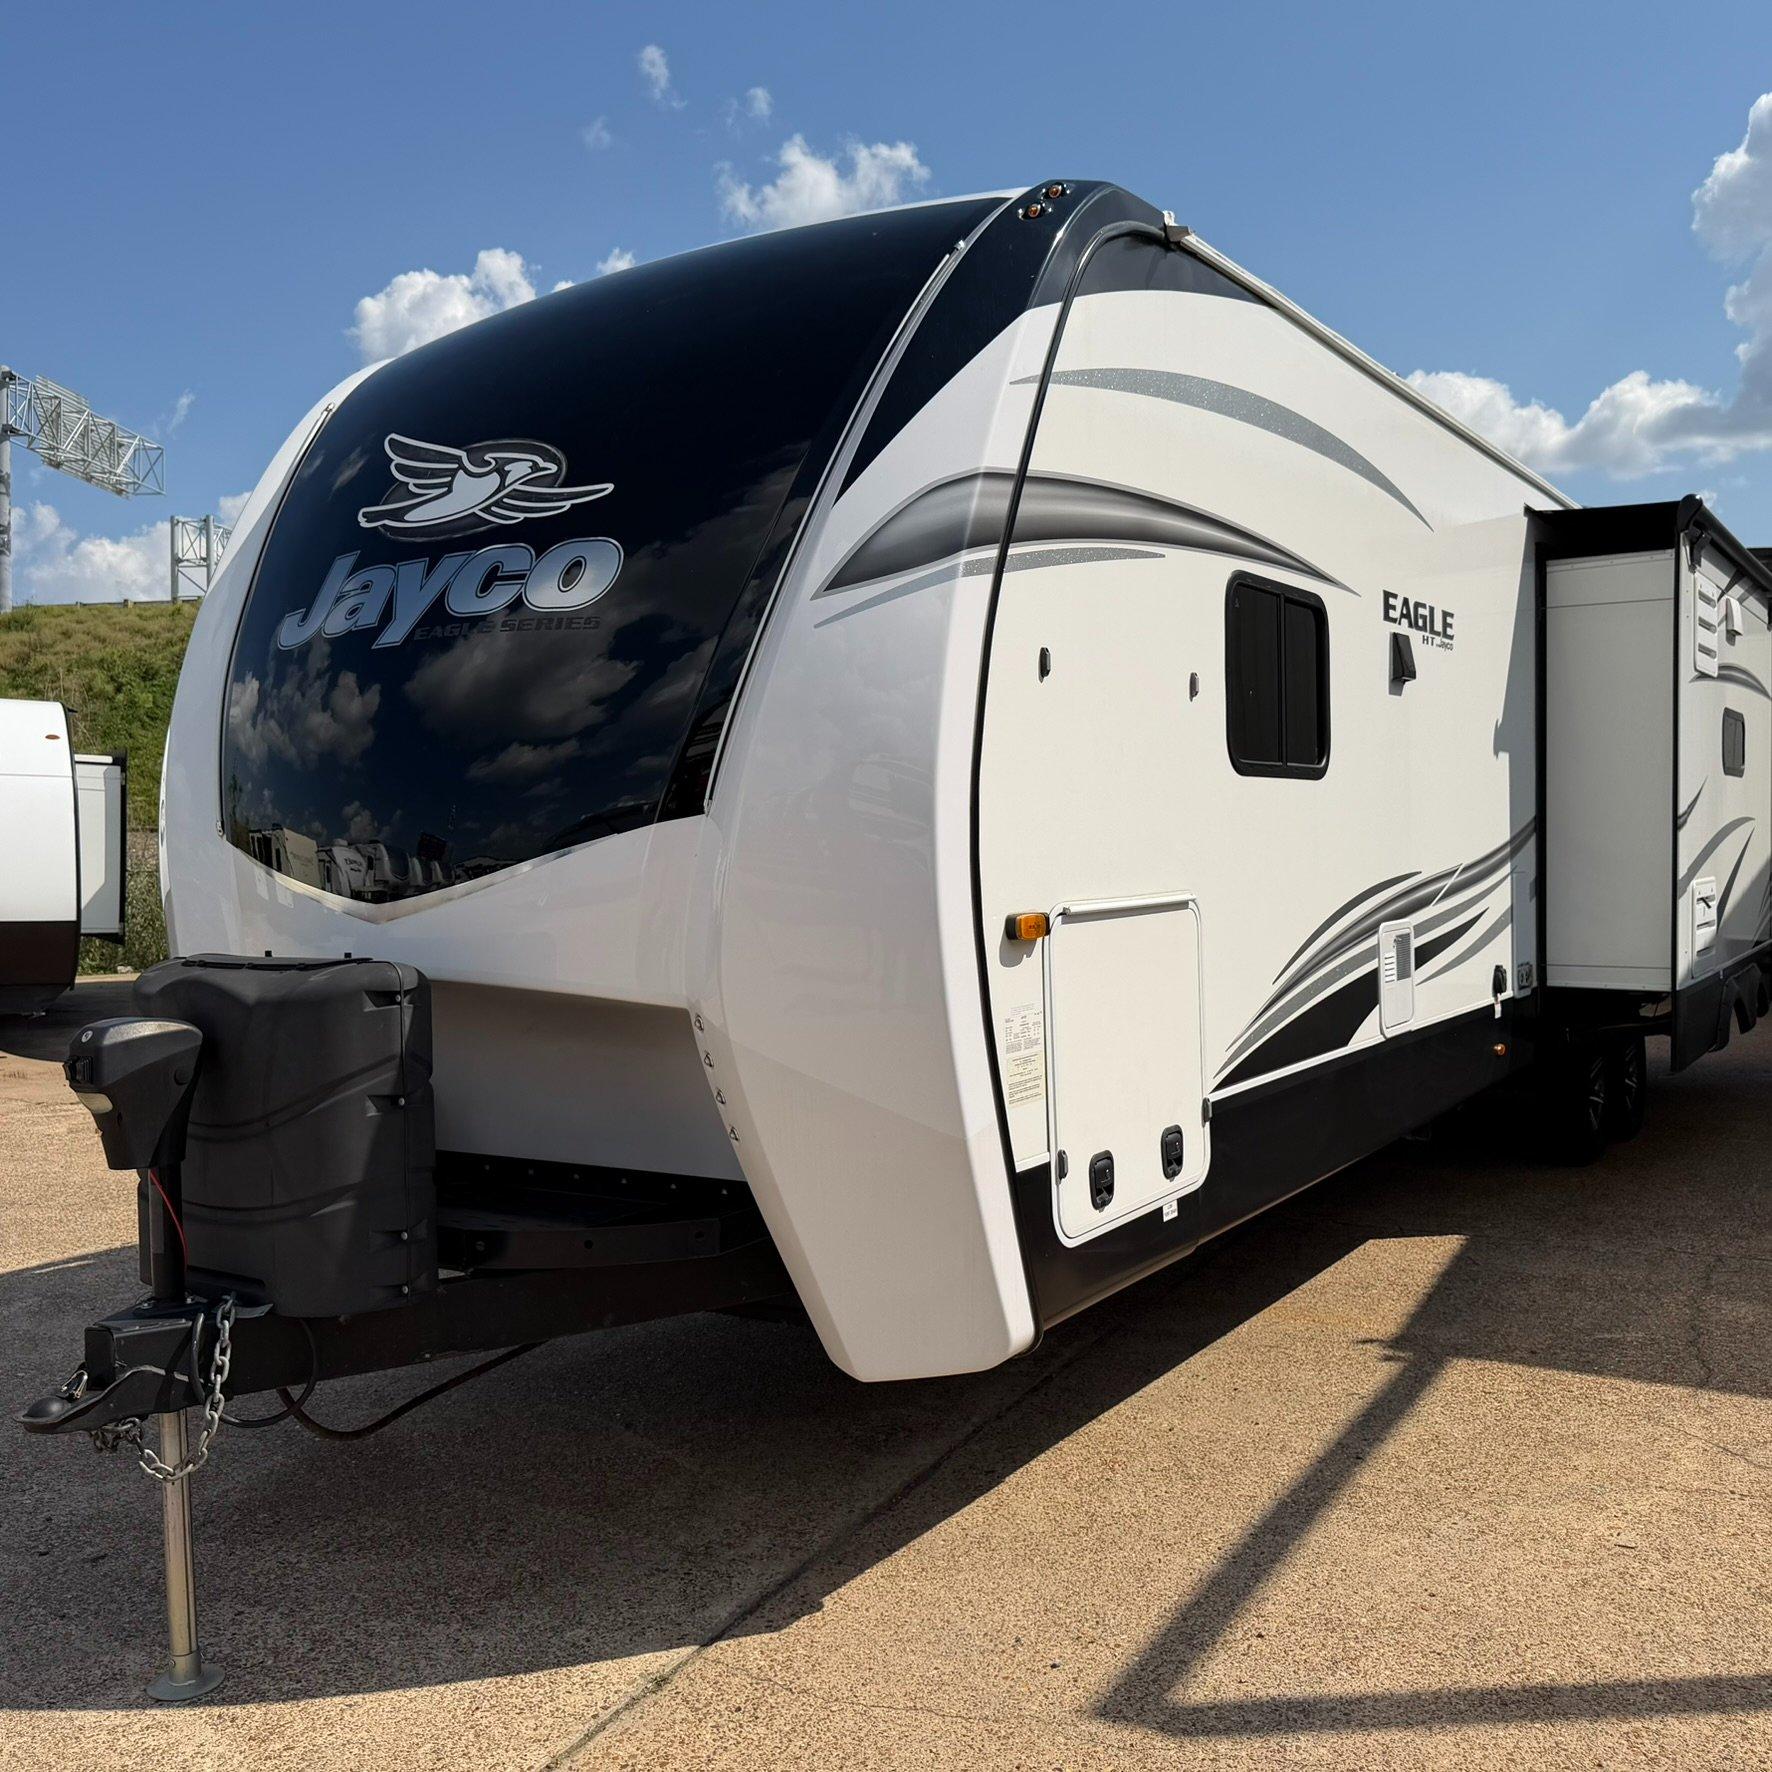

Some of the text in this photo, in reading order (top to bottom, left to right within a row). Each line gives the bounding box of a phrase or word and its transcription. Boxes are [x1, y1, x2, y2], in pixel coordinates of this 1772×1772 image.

[277, 537, 625, 650] Jayco
[413, 615, 601, 640] EAGLE SERIES
[1382, 589, 1455, 641] EAGLE
[1422, 634, 1436, 646] HT
